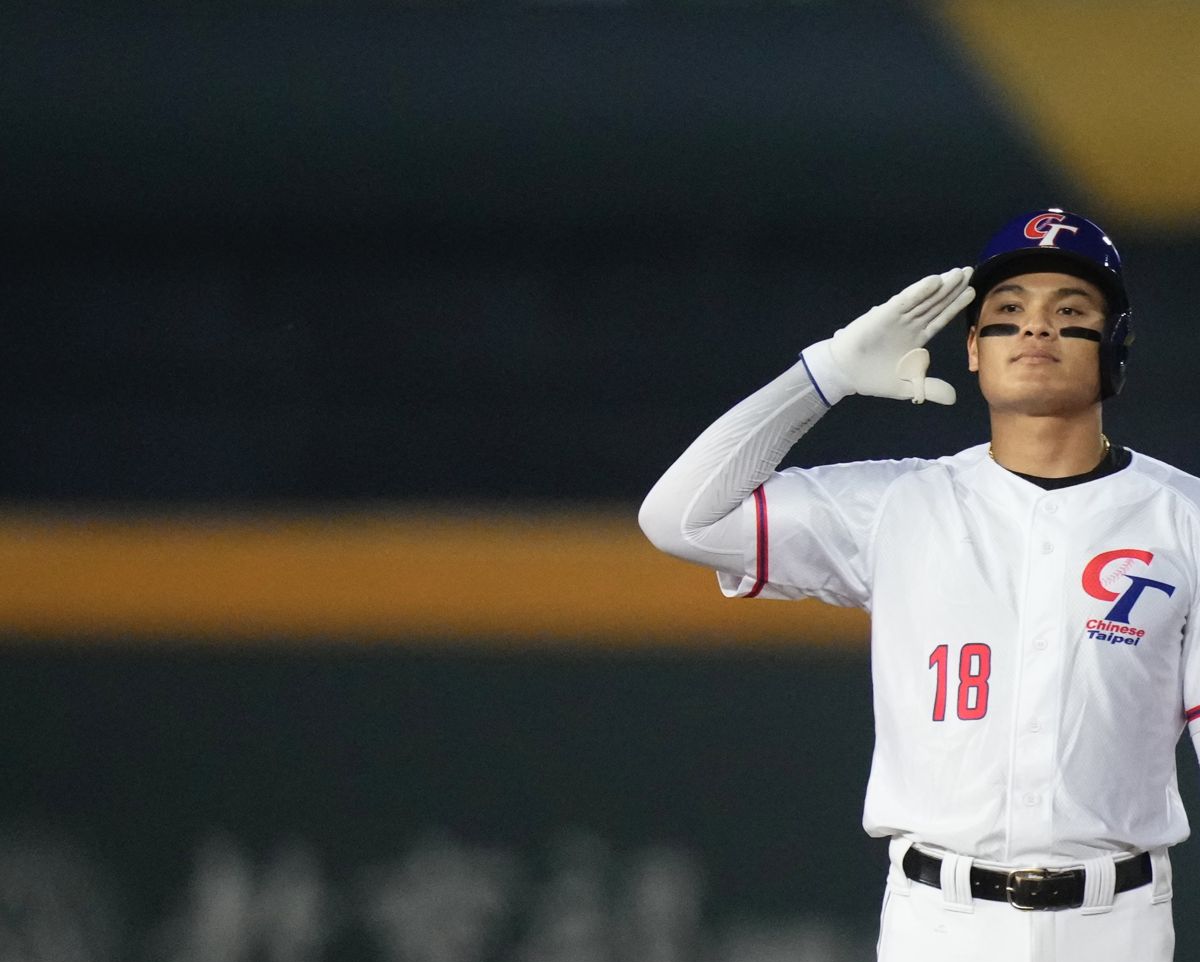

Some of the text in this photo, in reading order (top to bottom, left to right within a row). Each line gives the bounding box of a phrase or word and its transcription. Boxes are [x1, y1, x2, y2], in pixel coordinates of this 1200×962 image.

[1086, 619, 1145, 638] Chinese
[1087, 630, 1140, 646] Taipei
[929, 642, 991, 721] 18
